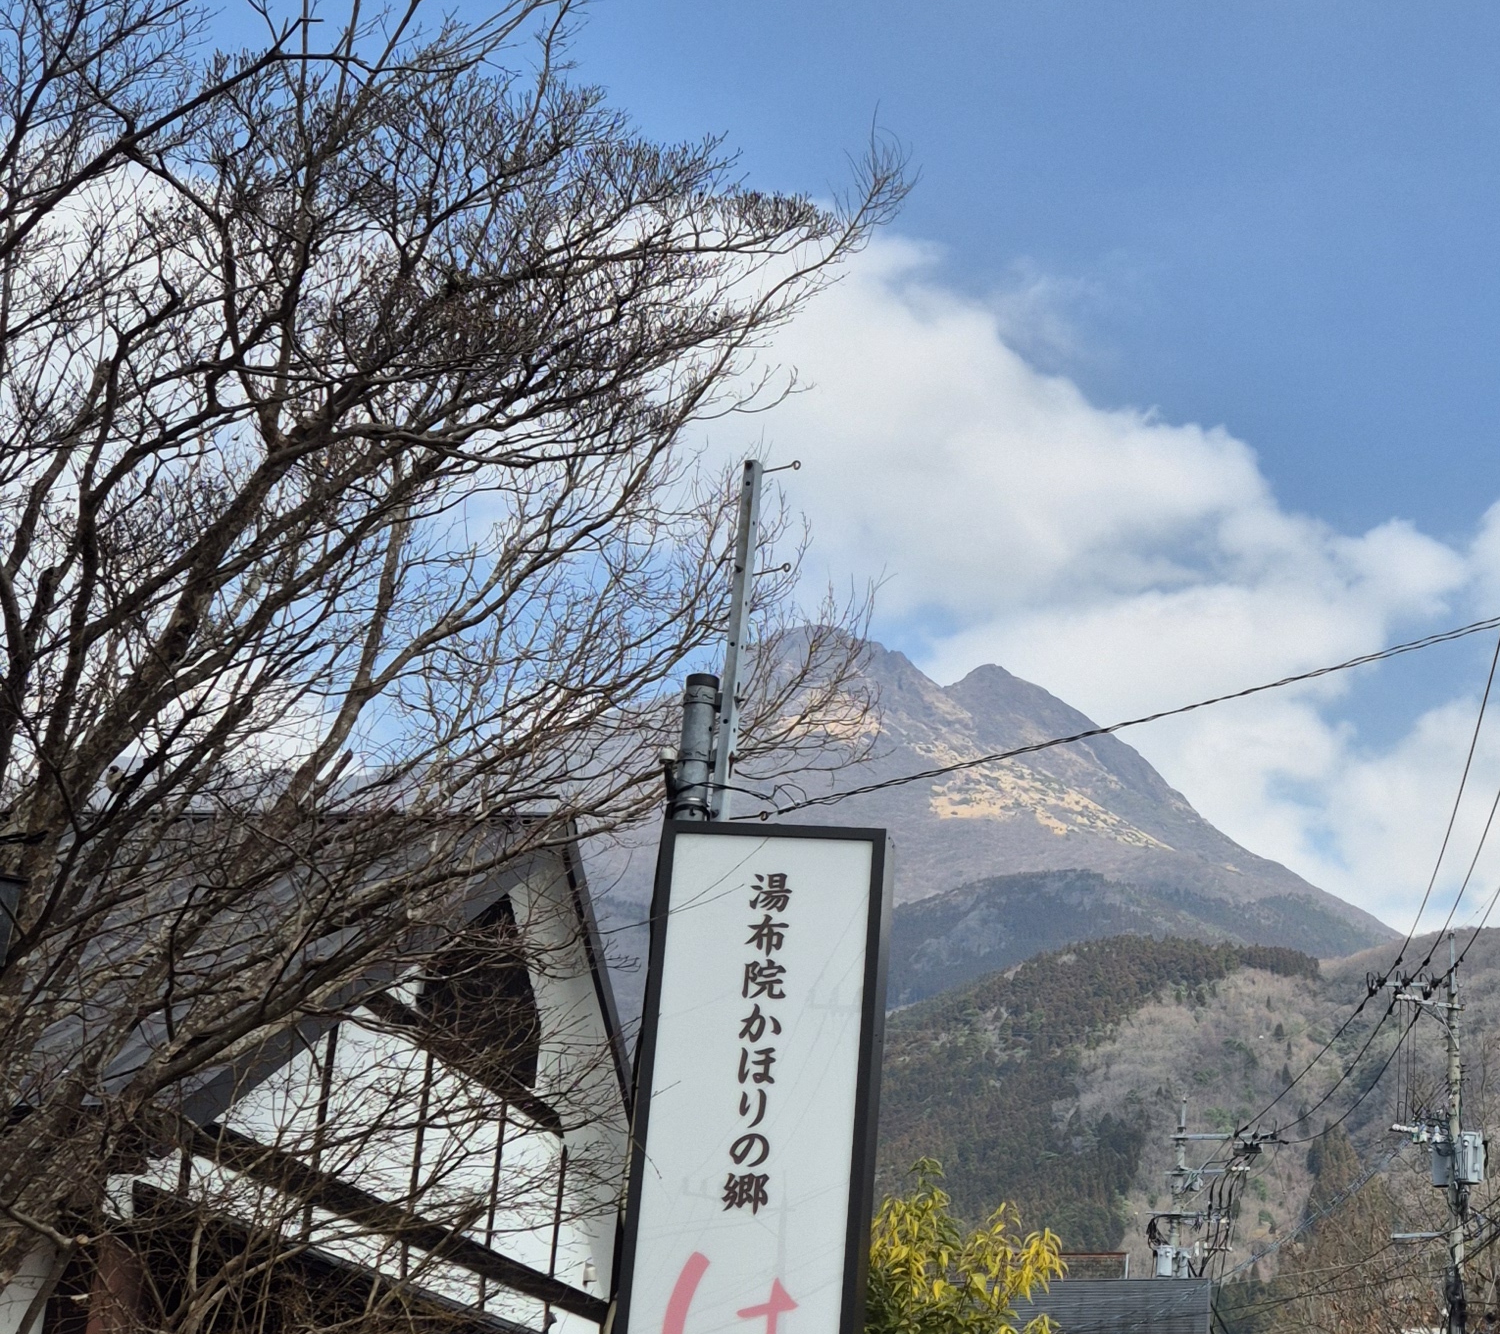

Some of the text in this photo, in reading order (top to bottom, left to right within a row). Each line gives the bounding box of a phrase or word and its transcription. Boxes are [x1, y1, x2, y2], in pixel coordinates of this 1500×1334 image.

[721, 871, 793, 1216] 湯布院かほりの郷
